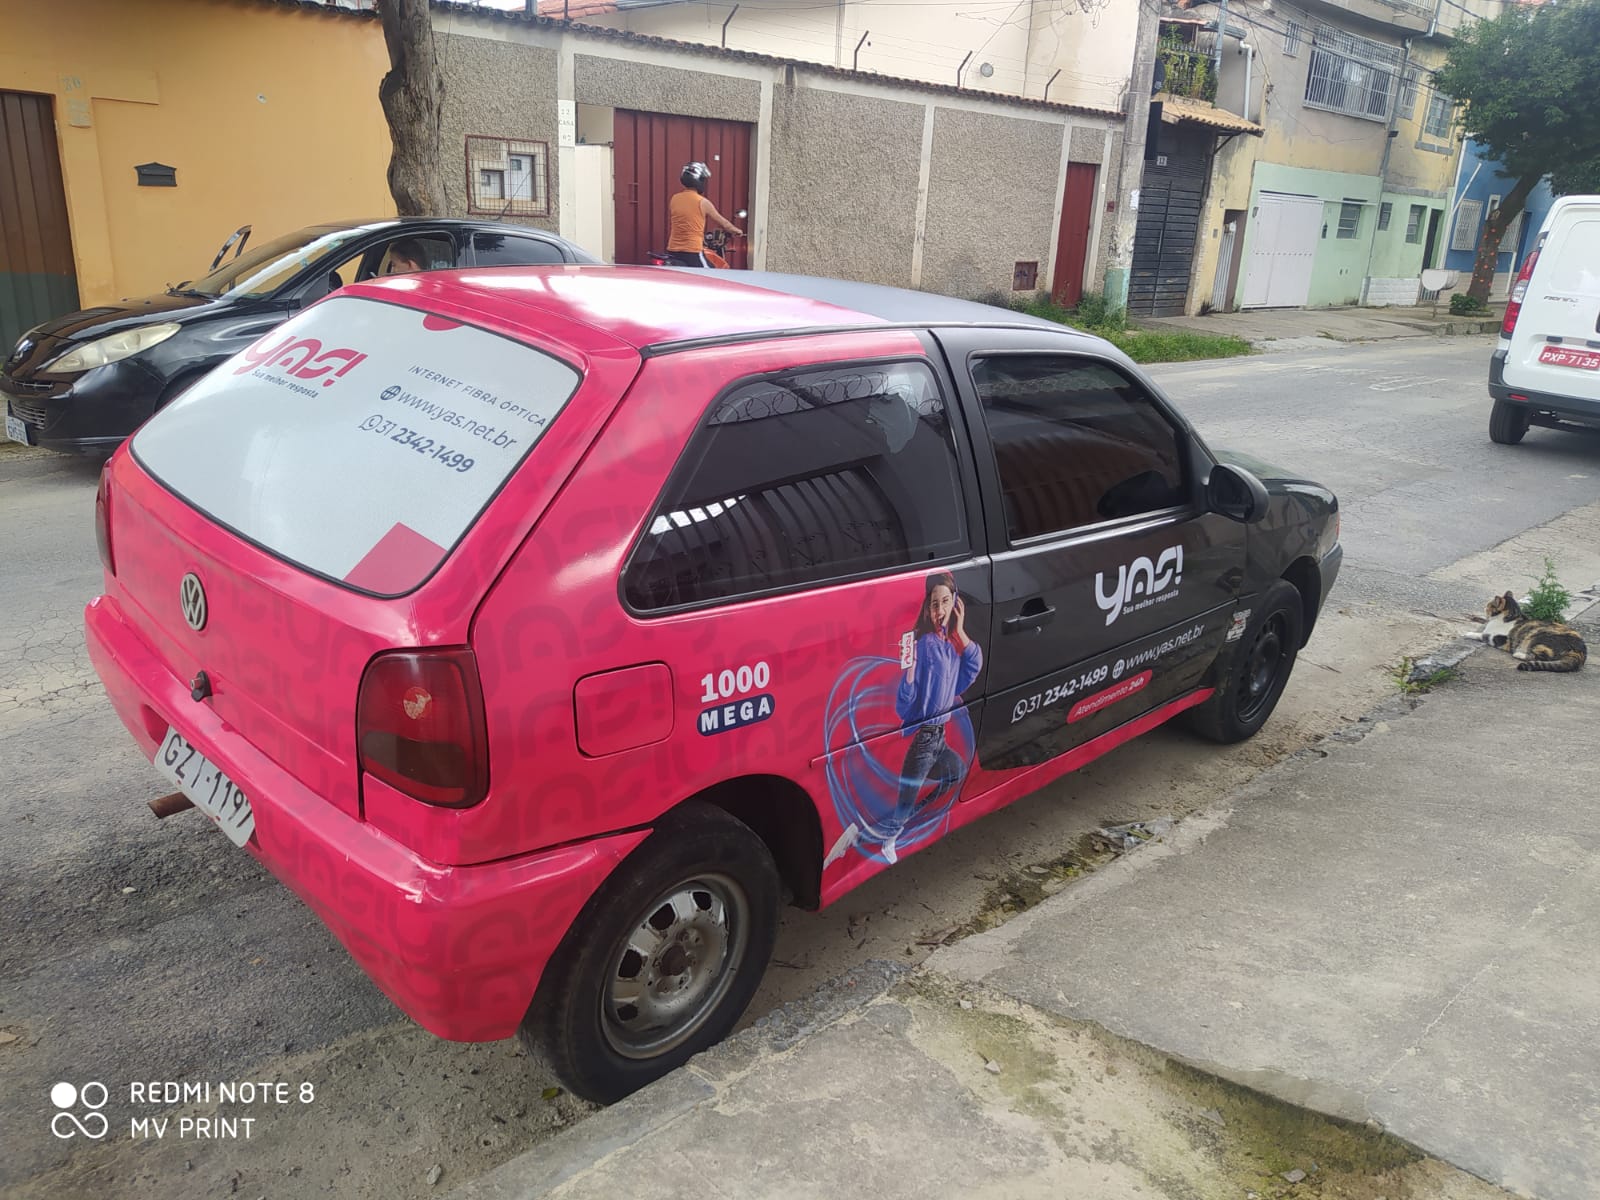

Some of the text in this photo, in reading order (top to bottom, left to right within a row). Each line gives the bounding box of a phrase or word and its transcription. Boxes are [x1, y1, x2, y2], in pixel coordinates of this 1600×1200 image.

[264, 374, 289, 387] melhor
[286, 381, 319, 399] resposta
[408, 365, 463, 390] INTERNET
[462, 385, 497, 406] FIBRA
[398, 391, 518, 450] www.yas.net.br
[390, 427, 476, 473] 2342-1499
[1134, 598, 1155, 610] melhor
[1156, 589, 1179, 603] resposta
[700, 661, 771, 703] 1000
[1043, 665, 1109, 706] 2342-1499
[1126, 624, 1205, 670] www.yas.net.br
[701, 697, 771, 733] MEGA
[1074, 685, 1129, 716] Atendimento
